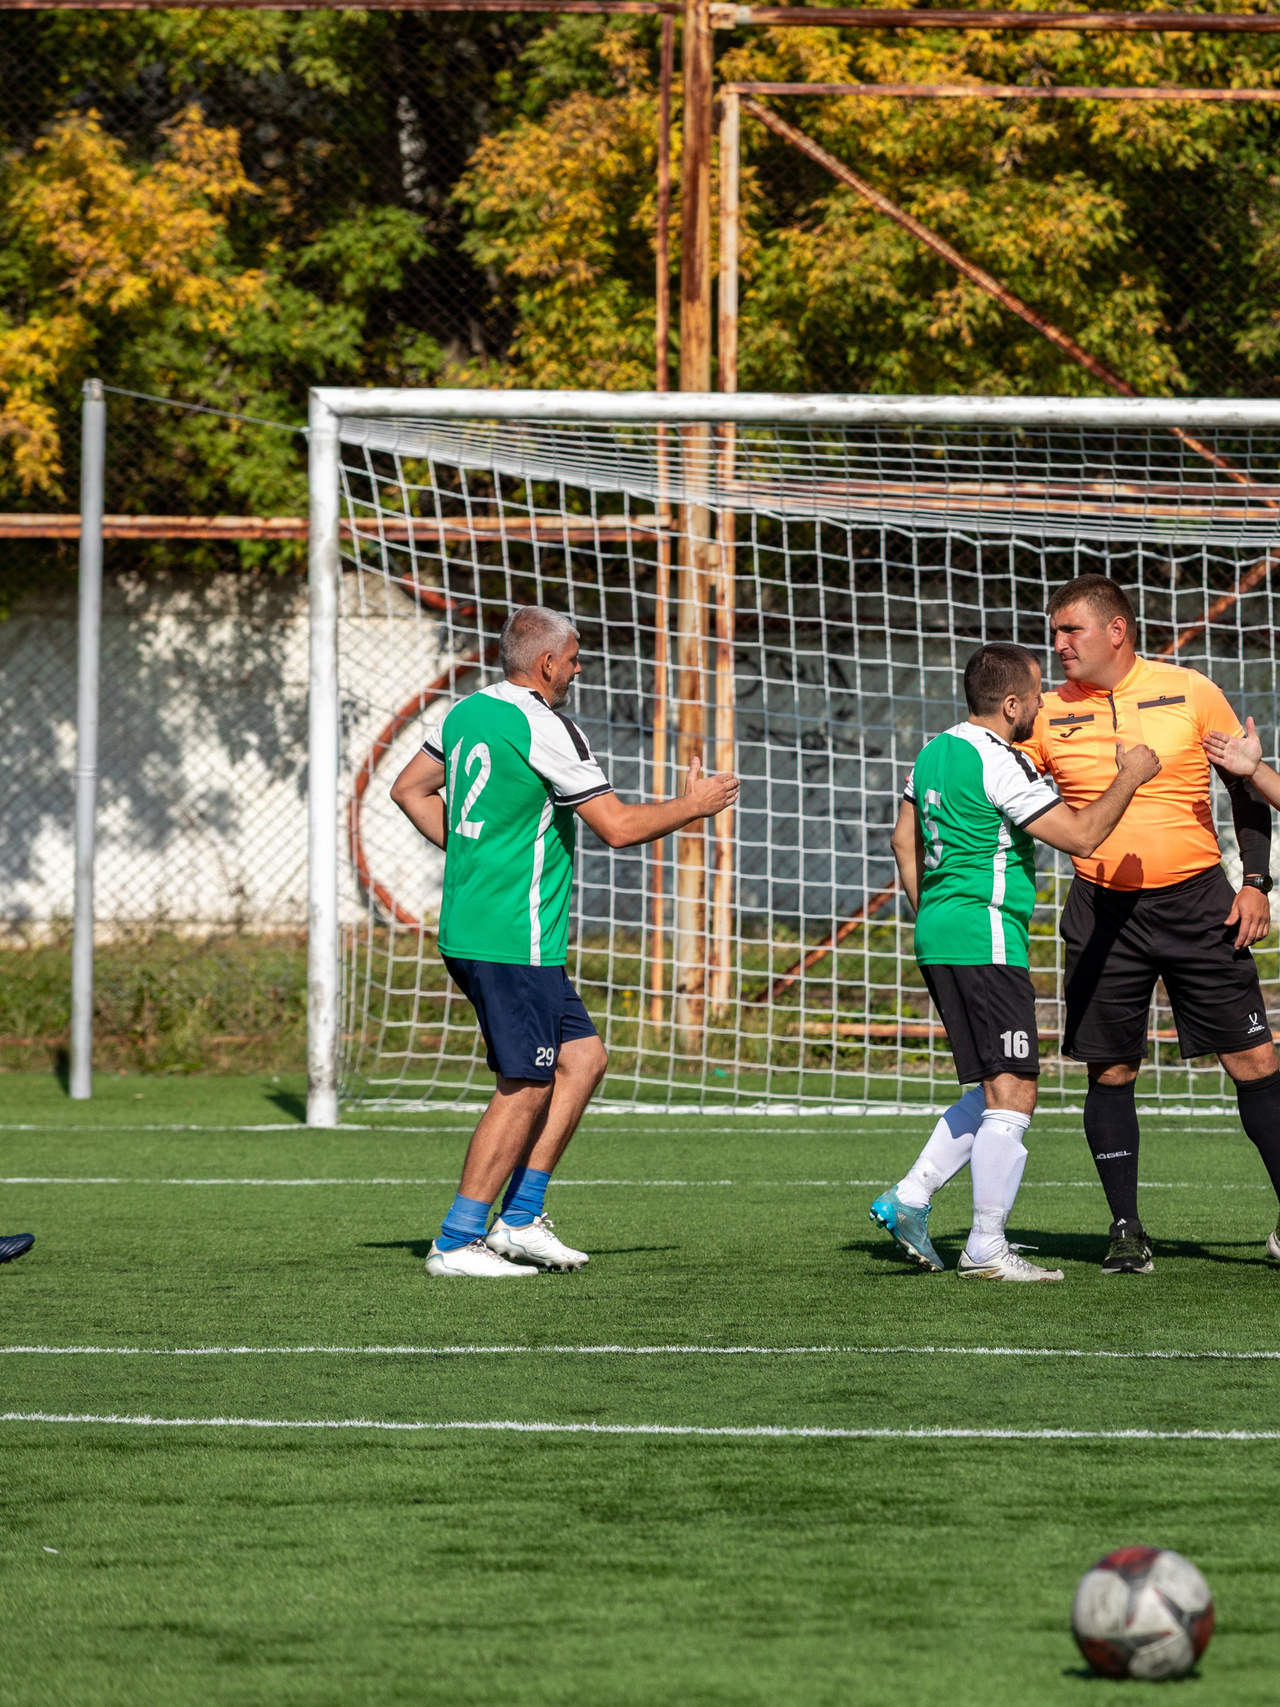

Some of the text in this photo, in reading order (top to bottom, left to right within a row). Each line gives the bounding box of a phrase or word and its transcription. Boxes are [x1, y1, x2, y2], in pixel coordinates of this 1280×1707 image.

[448, 735, 491, 840] 12
[535, 1046, 555, 1067] 29
[1000, 1030, 1030, 1058] 16
